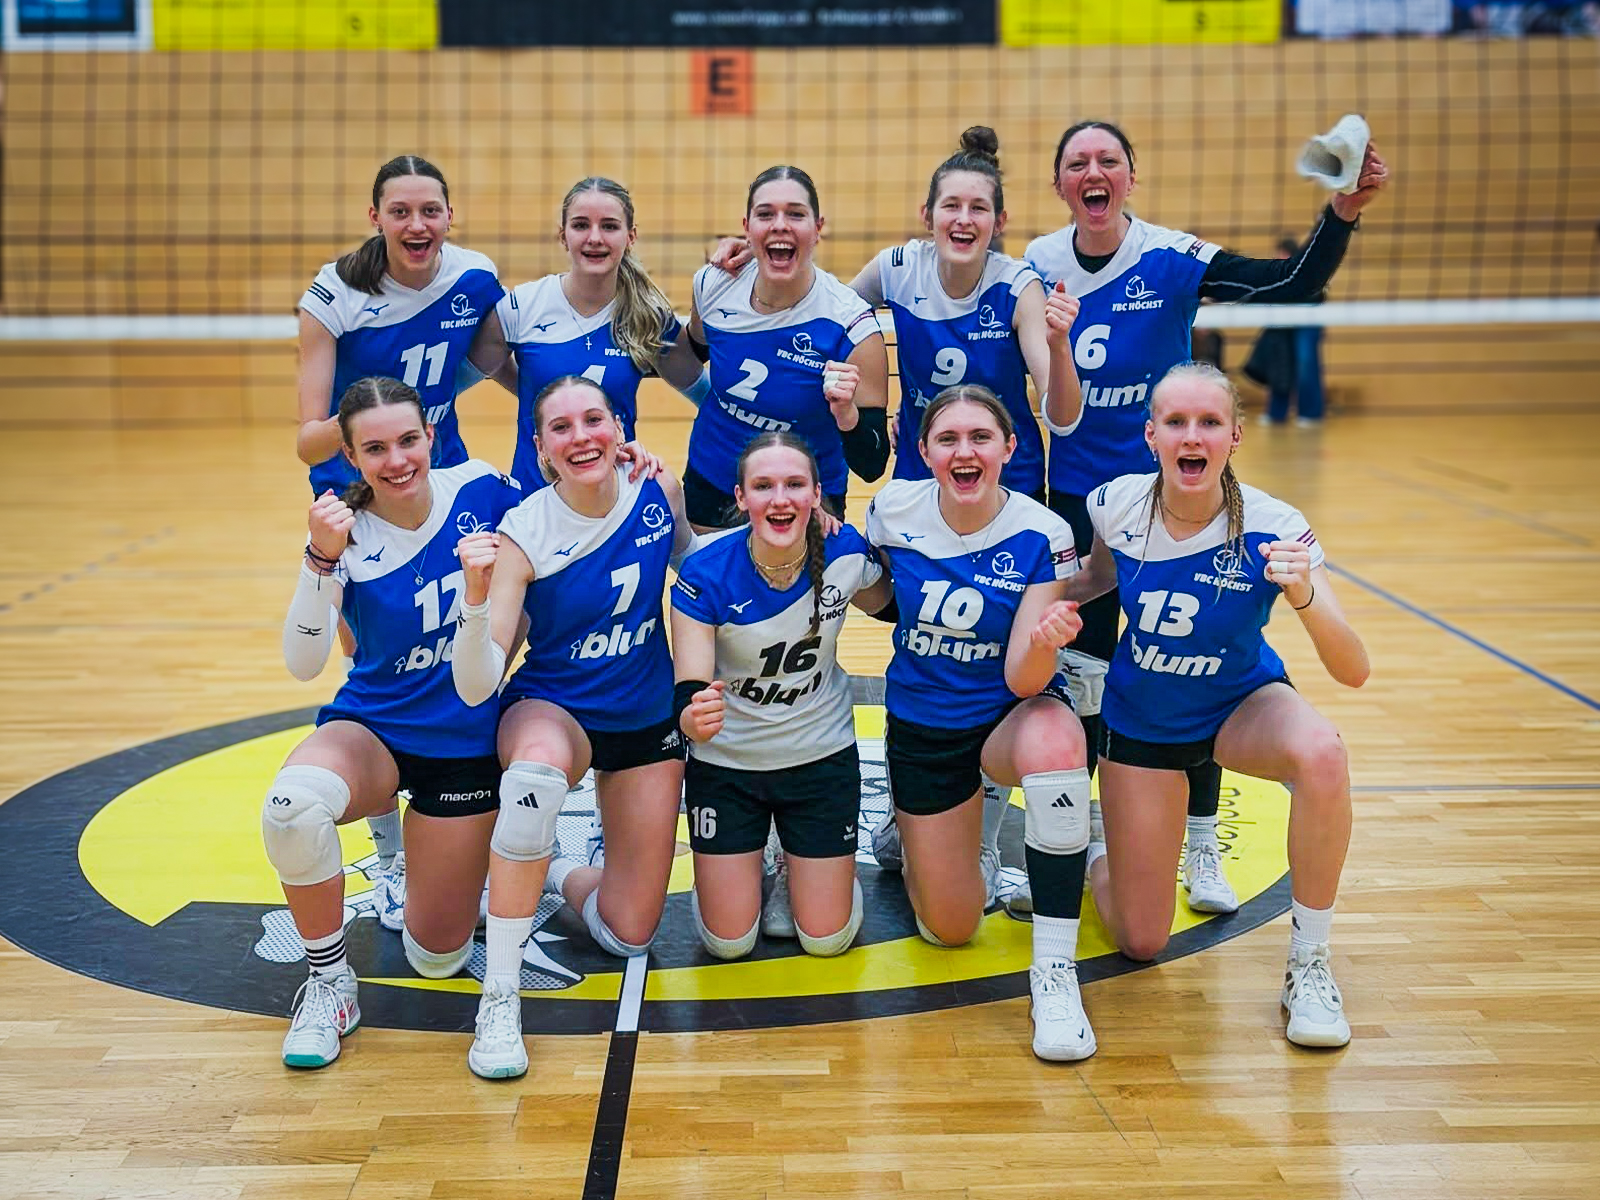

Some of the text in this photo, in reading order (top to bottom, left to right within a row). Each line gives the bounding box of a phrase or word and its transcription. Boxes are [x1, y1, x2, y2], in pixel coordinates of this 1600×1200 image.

[708, 57, 738, 97] E
[440, 320, 454, 330] VBC
[1112, 299, 1164, 312] VBC HÖCHST
[400, 341, 449, 387] 11
[604, 347, 621, 357] VBC
[776, 348, 794, 360] VBC
[930, 347, 968, 386] 9
[1074, 324, 1111, 370] 6
[725, 358, 769, 402] 2
[1081, 380, 1148, 407] lum
[634, 534, 653, 548] VBC
[414, 570, 466, 634] 12
[610, 561, 641, 618] 7
[973, 573, 1027, 593] VBC HÖCHST
[1193, 572, 1254, 593] VBC HÖCHST
[917, 579, 985, 631] 10
[1137, 589, 1200, 637] 13
[758, 636, 823, 678] 16
[908, 628, 1001, 662] blum
[1131, 632, 1223, 677] blum
[691, 806, 717, 840] 16
